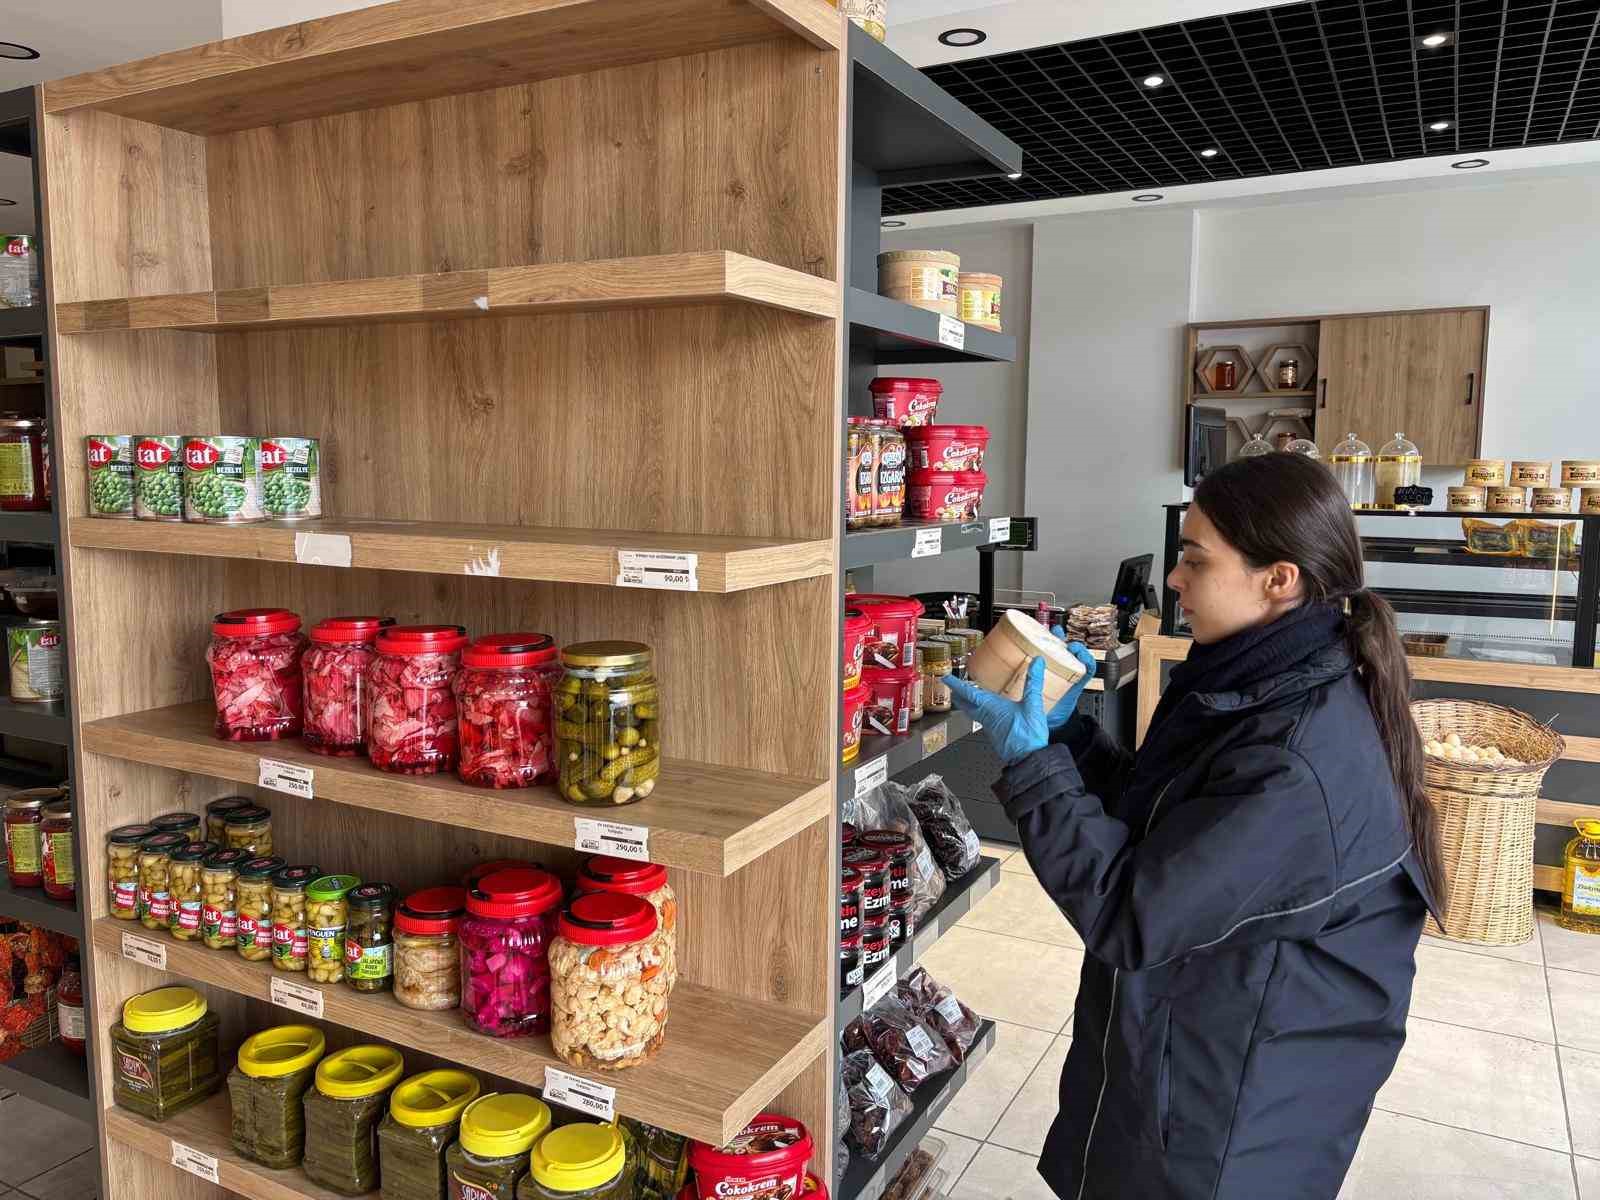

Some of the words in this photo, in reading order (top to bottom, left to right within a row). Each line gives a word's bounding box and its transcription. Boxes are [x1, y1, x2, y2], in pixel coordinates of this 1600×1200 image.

[137, 446, 165, 463] tat
[186, 447, 213, 464] tat
[261, 448, 284, 464] at
